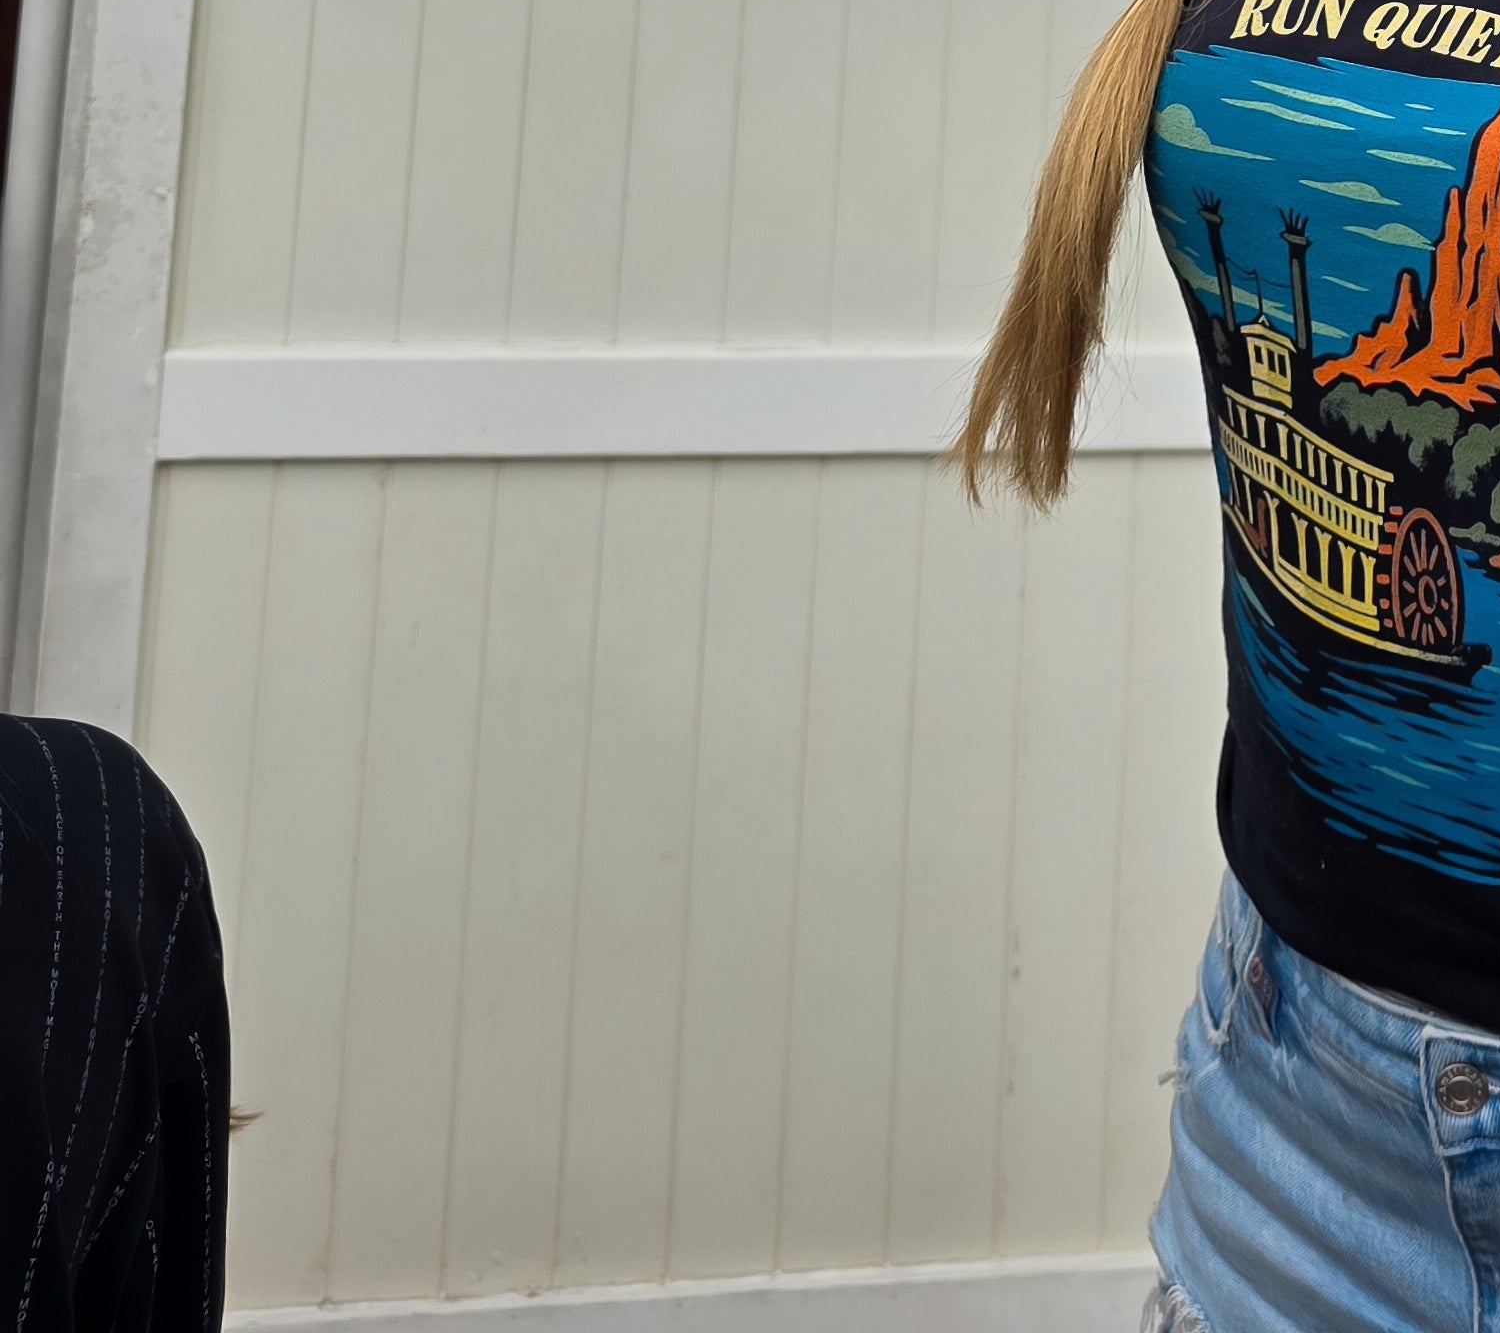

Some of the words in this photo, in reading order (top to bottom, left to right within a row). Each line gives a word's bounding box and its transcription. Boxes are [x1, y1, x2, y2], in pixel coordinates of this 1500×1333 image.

[55, 793, 64, 841] PLACE
[56, 845, 64, 866] ON
[55, 870, 64, 922] EARTH
[53, 930, 62, 963] THE
[129, 991, 149, 1036] MOST
[44, 1161, 55, 1185] ON
[145, 1219, 156, 1241] ON
